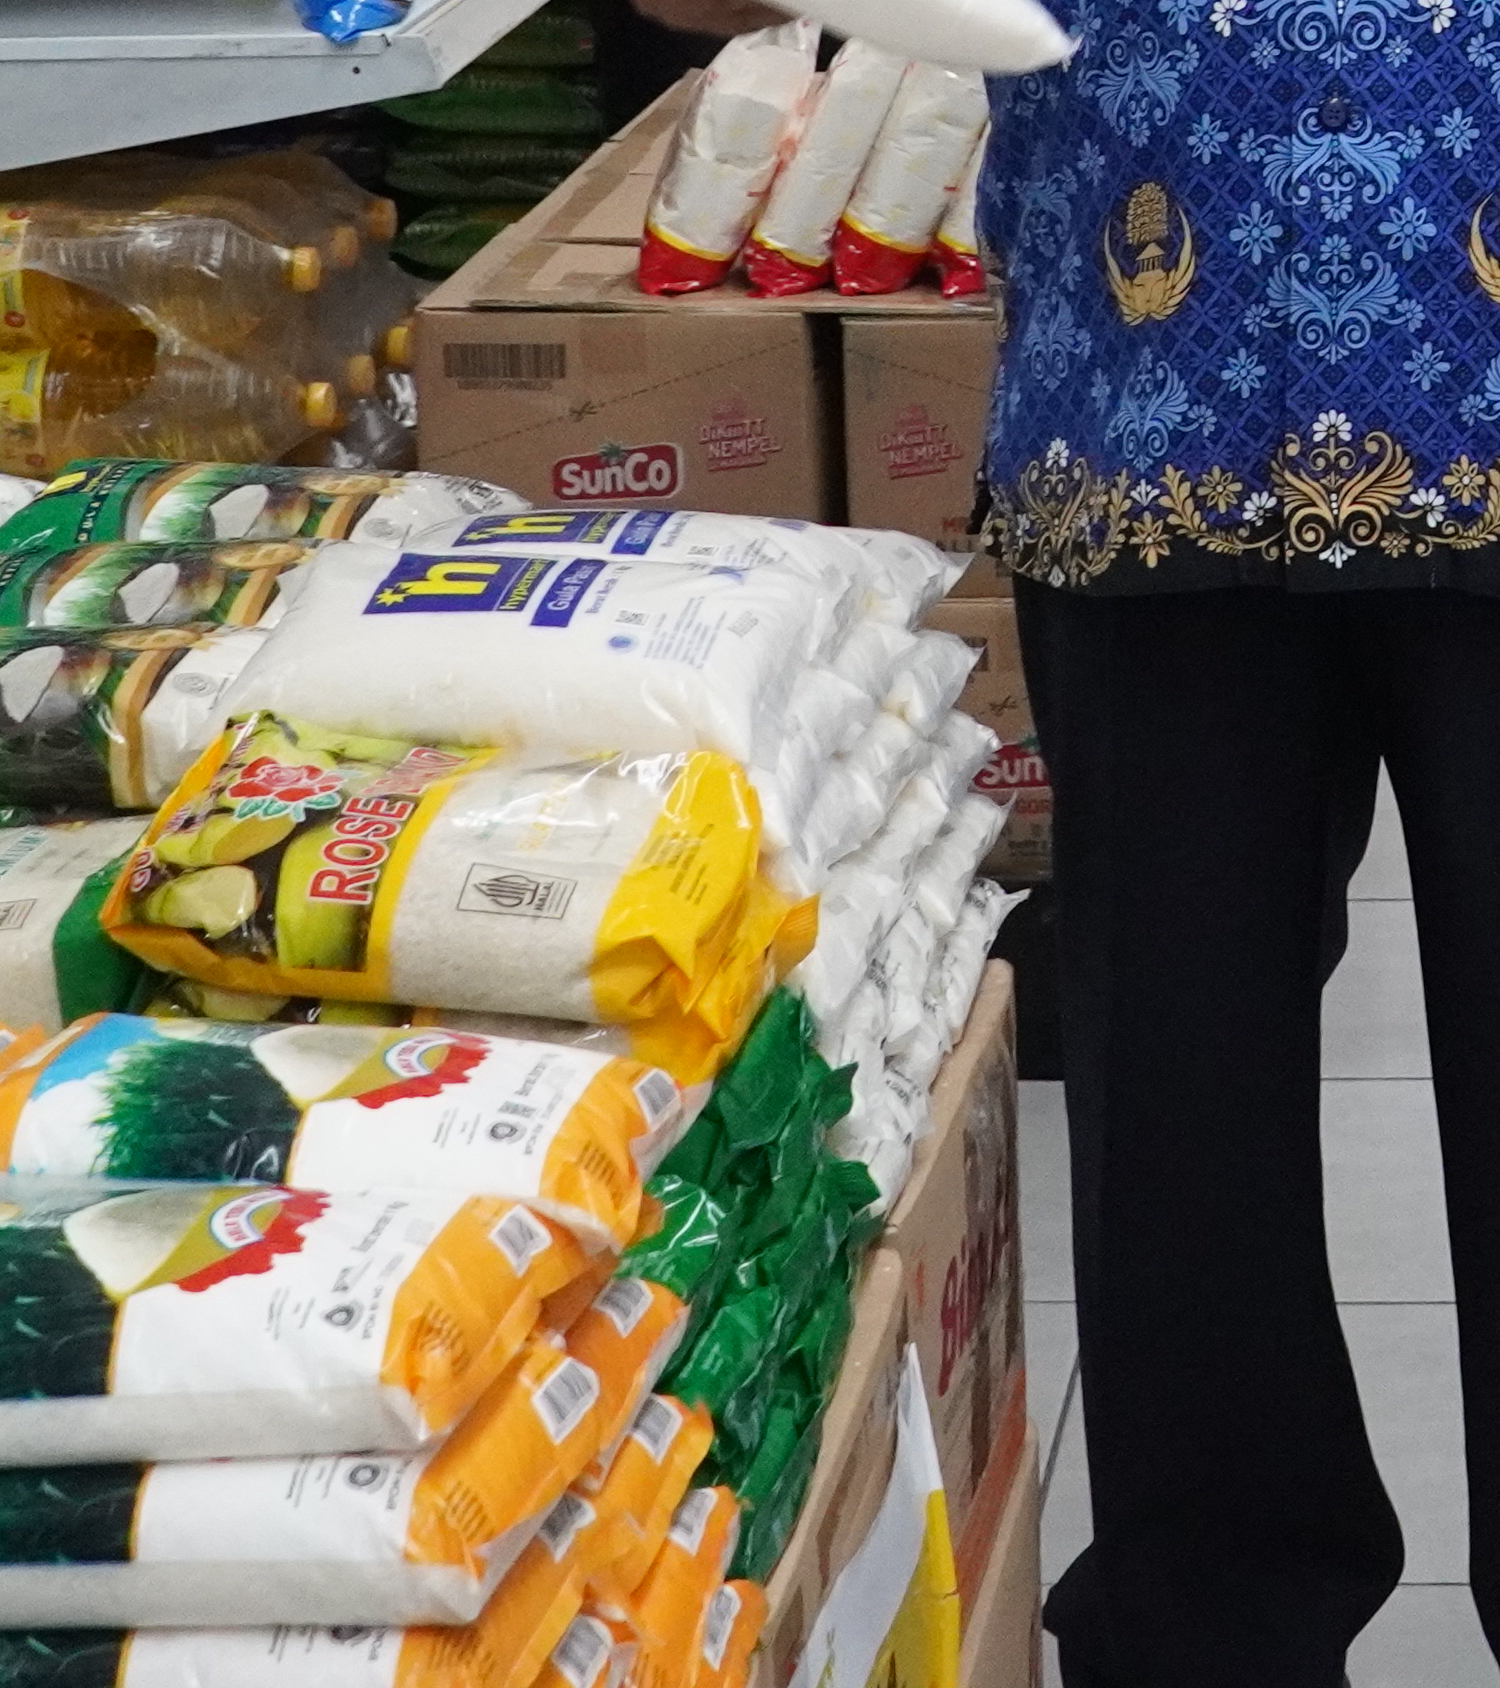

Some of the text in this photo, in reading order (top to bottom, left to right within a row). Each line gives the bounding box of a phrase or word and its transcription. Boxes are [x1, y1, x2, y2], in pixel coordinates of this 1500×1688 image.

[707, 436, 782, 460] NEMPEL
[560, 451, 671, 495] SunCo
[499, 558, 557, 611] hypermart
[562, 559, 600, 589] Pasir
[981, 757, 1045, 786] Sun
[309, 795, 411, 904] ROSE
